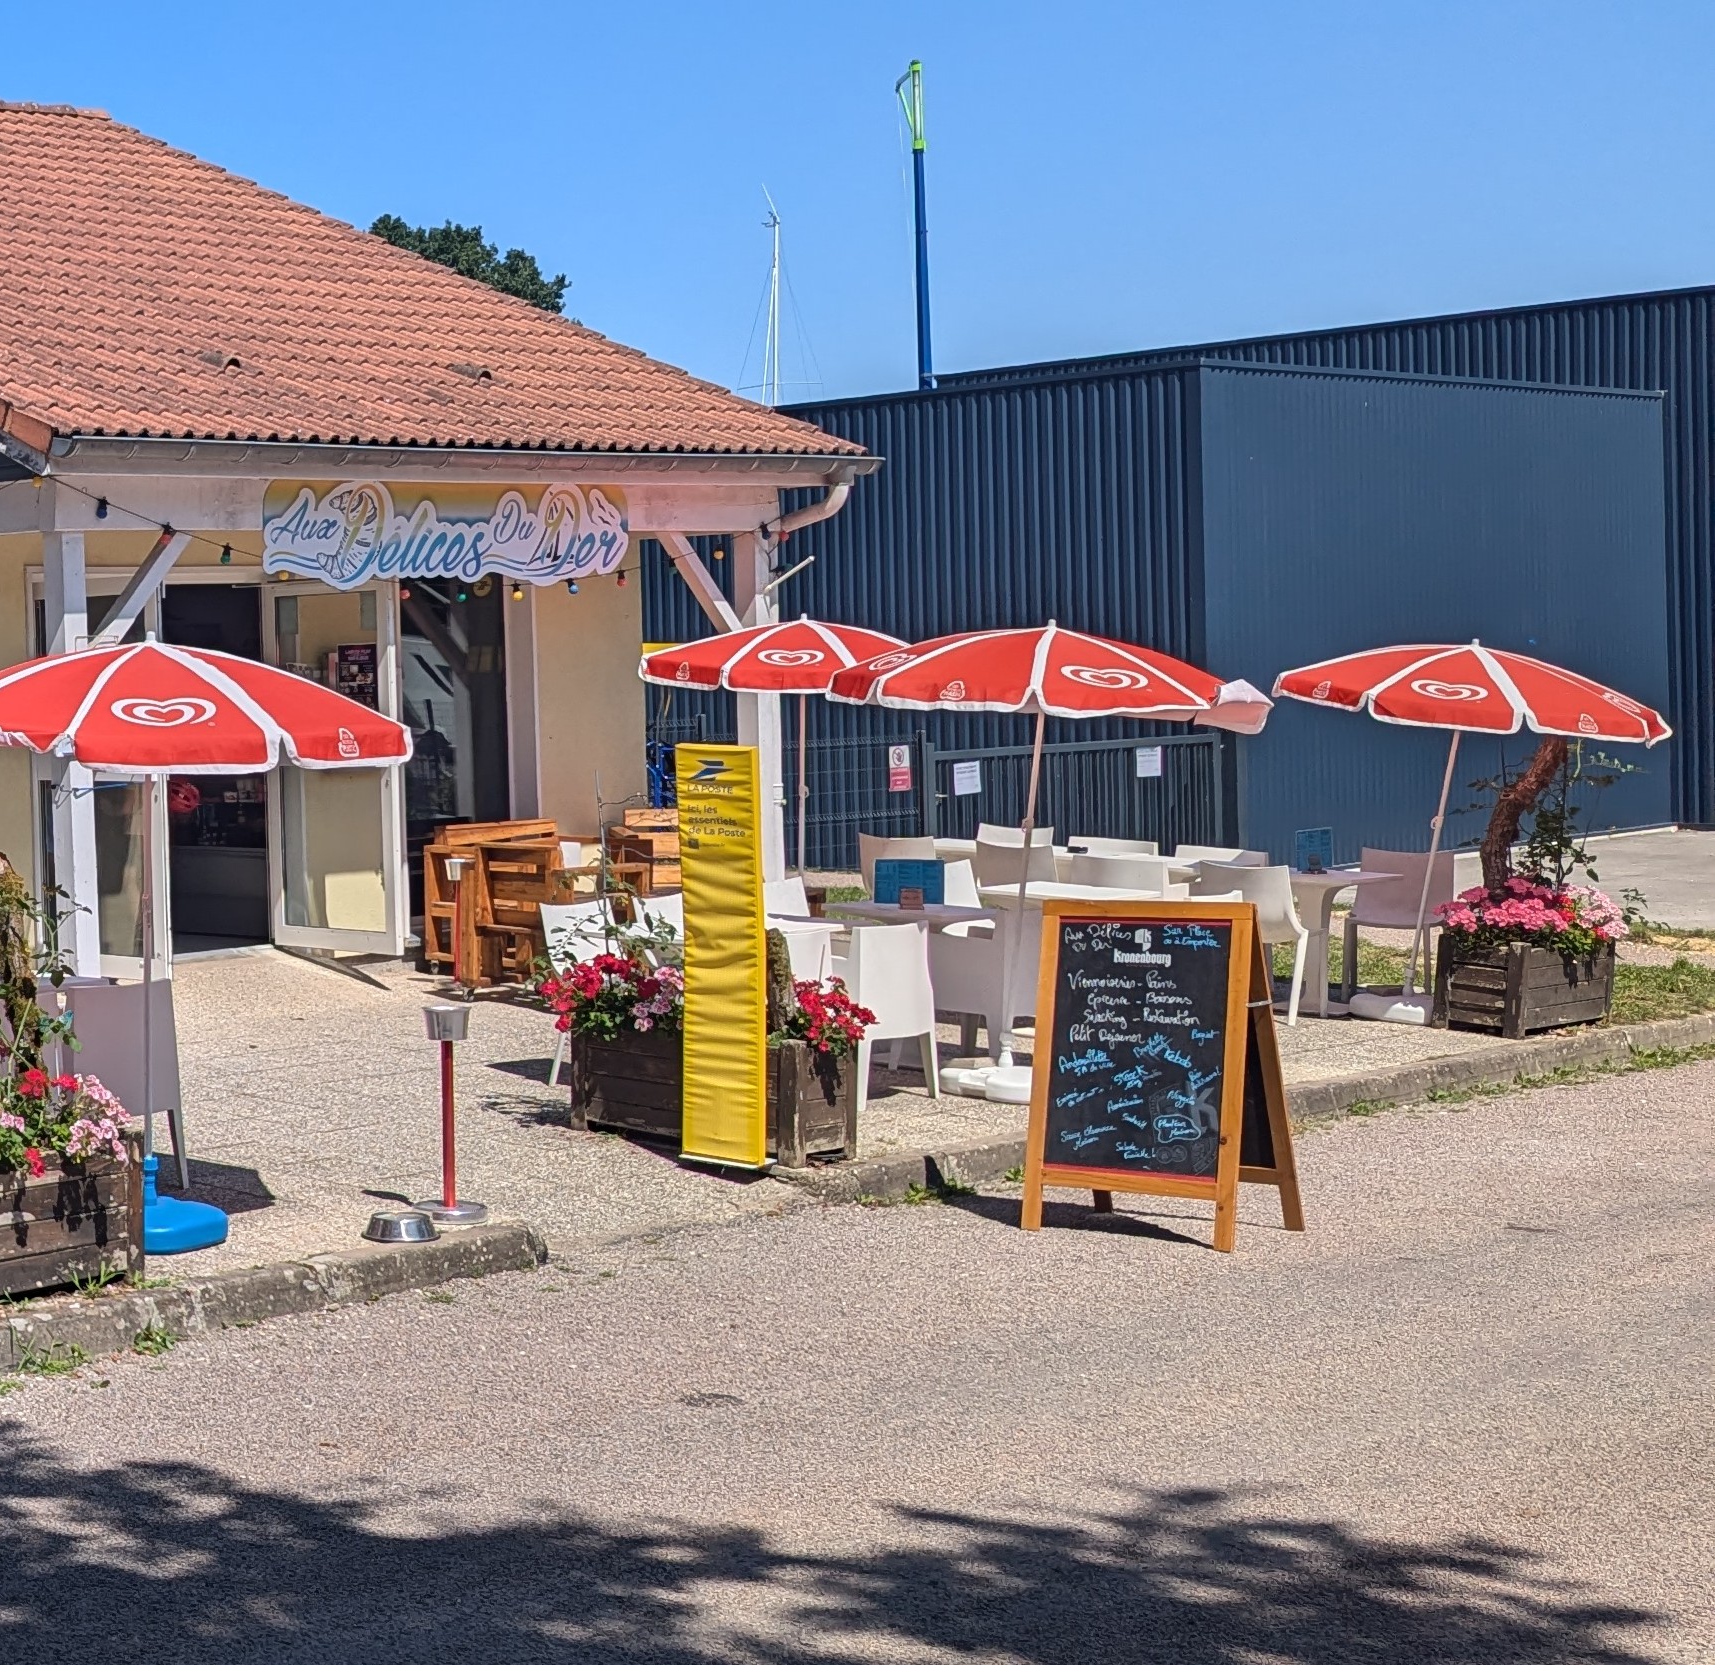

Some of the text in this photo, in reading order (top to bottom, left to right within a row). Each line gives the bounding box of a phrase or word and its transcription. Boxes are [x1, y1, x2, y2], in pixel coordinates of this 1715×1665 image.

[270, 483, 627, 584] Aux Délices Du Der
[687, 784, 734, 795] LA POSTE
[688, 804, 718, 815] Ici, les
[688, 816, 738, 827] essentiels
[689, 826, 746, 837] de La Poste
[1112, 948, 1172, 968] Kronenbourg
[1069, 1023, 1095, 1043] Petit
